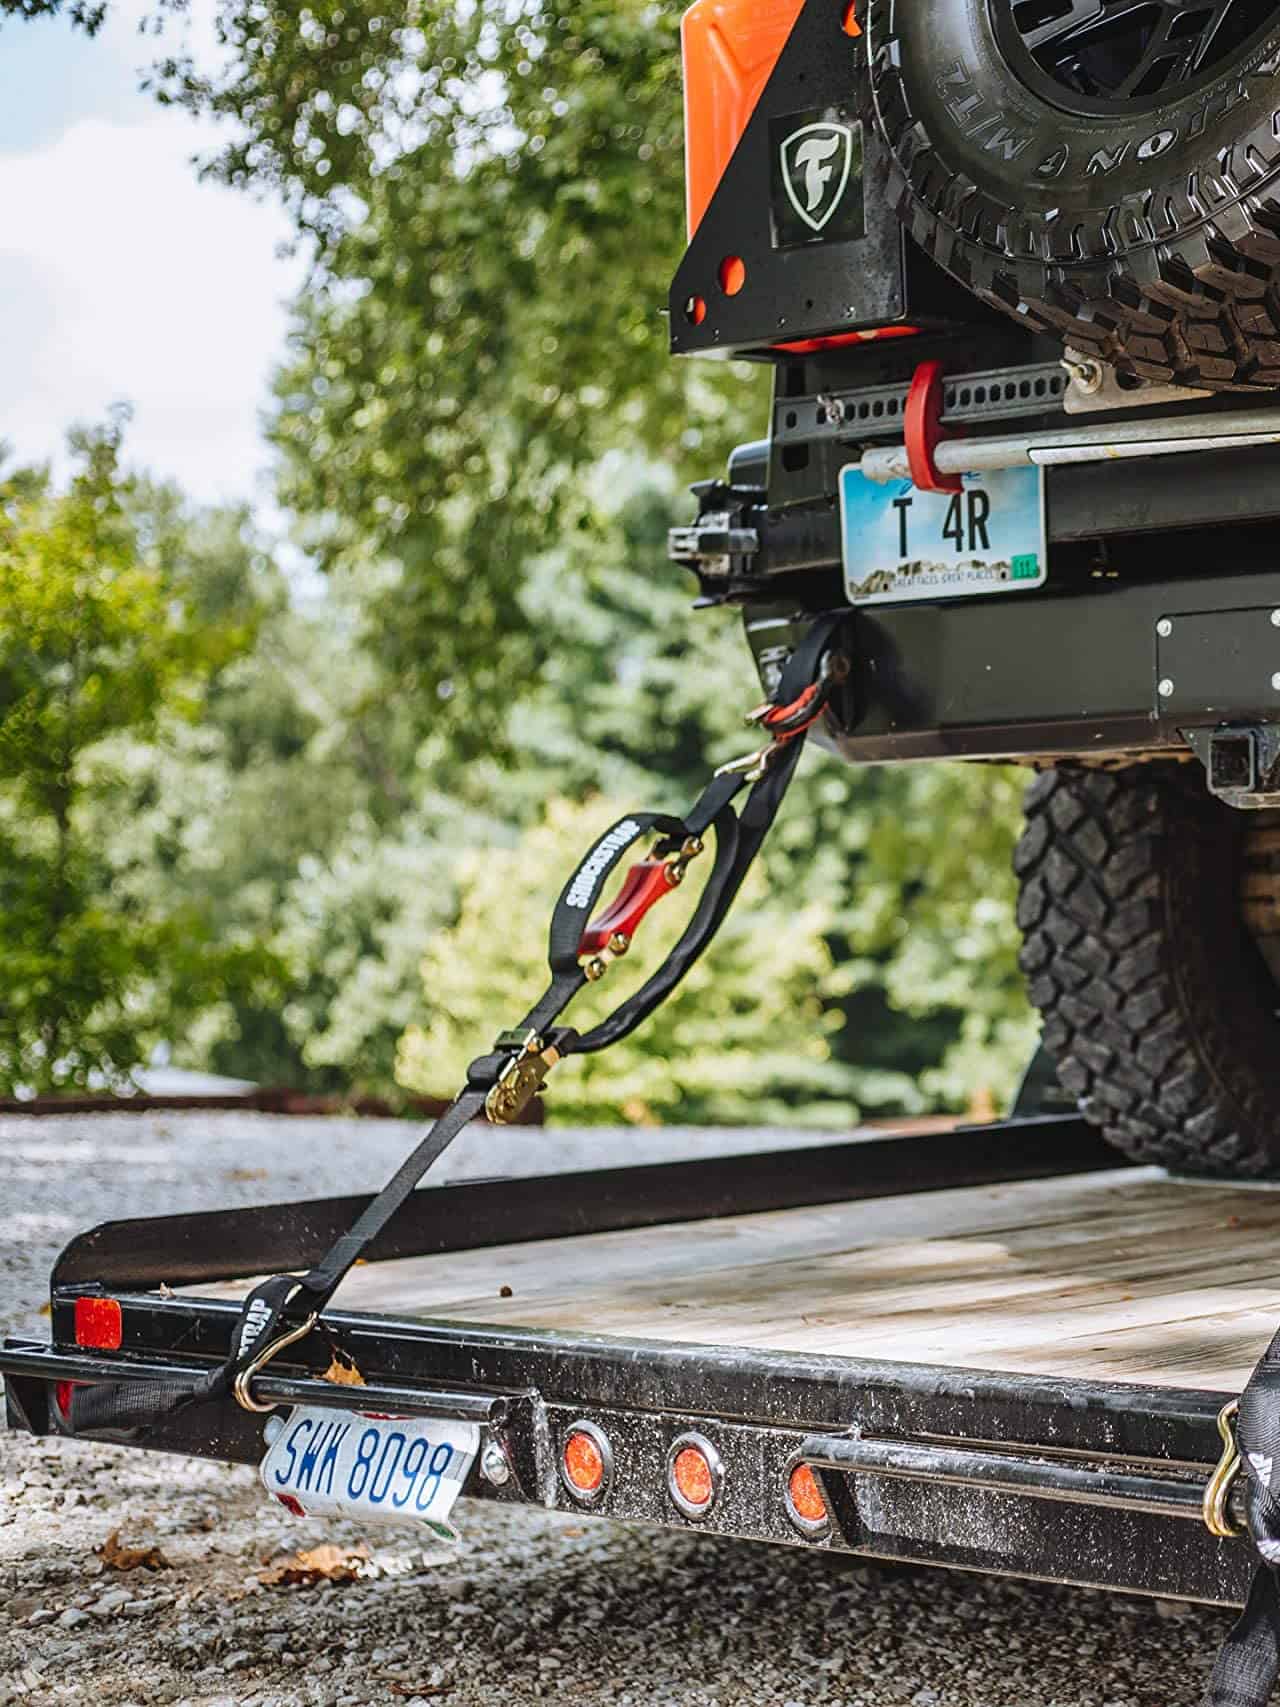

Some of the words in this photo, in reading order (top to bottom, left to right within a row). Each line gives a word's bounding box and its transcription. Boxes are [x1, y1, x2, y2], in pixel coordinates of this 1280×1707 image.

[942, 489, 991, 553] 4R
[275, 1418, 352, 1495] SWK
[347, 1427, 454, 1512] 8098
